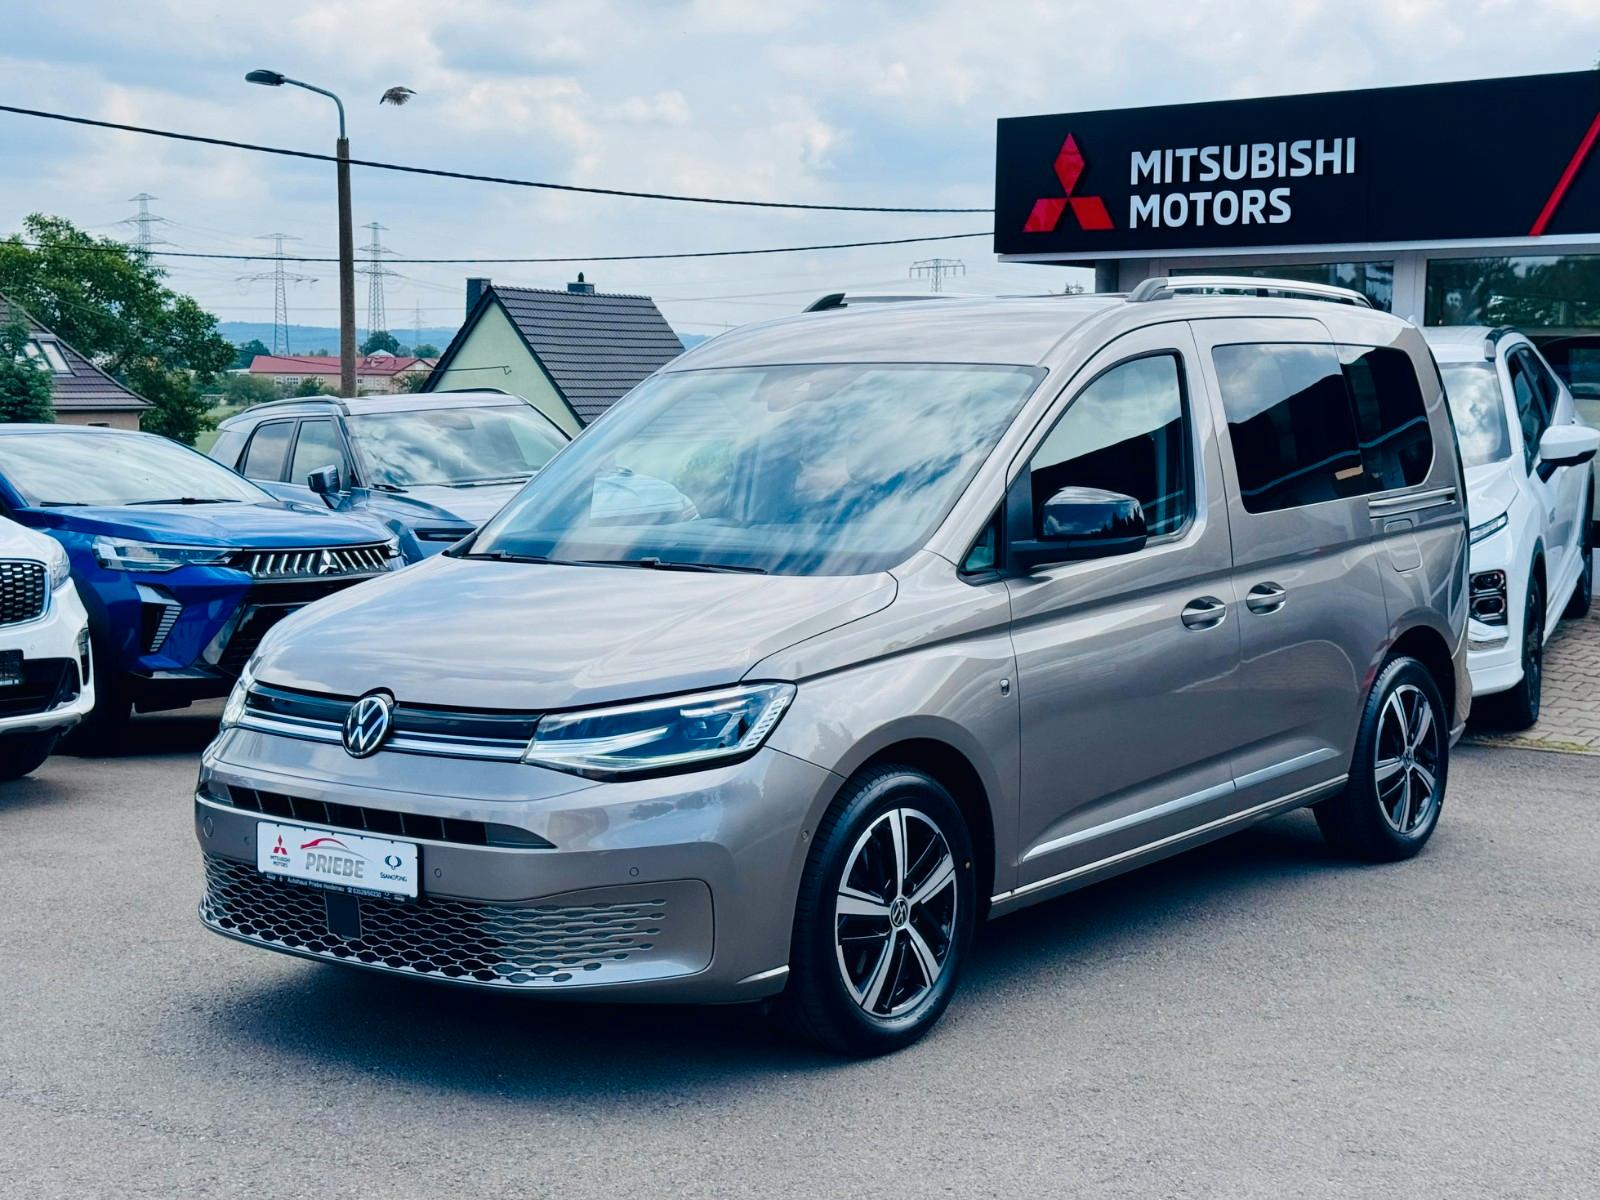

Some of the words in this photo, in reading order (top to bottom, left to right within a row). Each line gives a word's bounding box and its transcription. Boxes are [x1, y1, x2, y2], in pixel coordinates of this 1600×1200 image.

[1130, 136, 1357, 186] MITSUBISHI
[1129, 187, 1292, 229] MOTORS
[305, 852, 366, 879] PRIEBE
